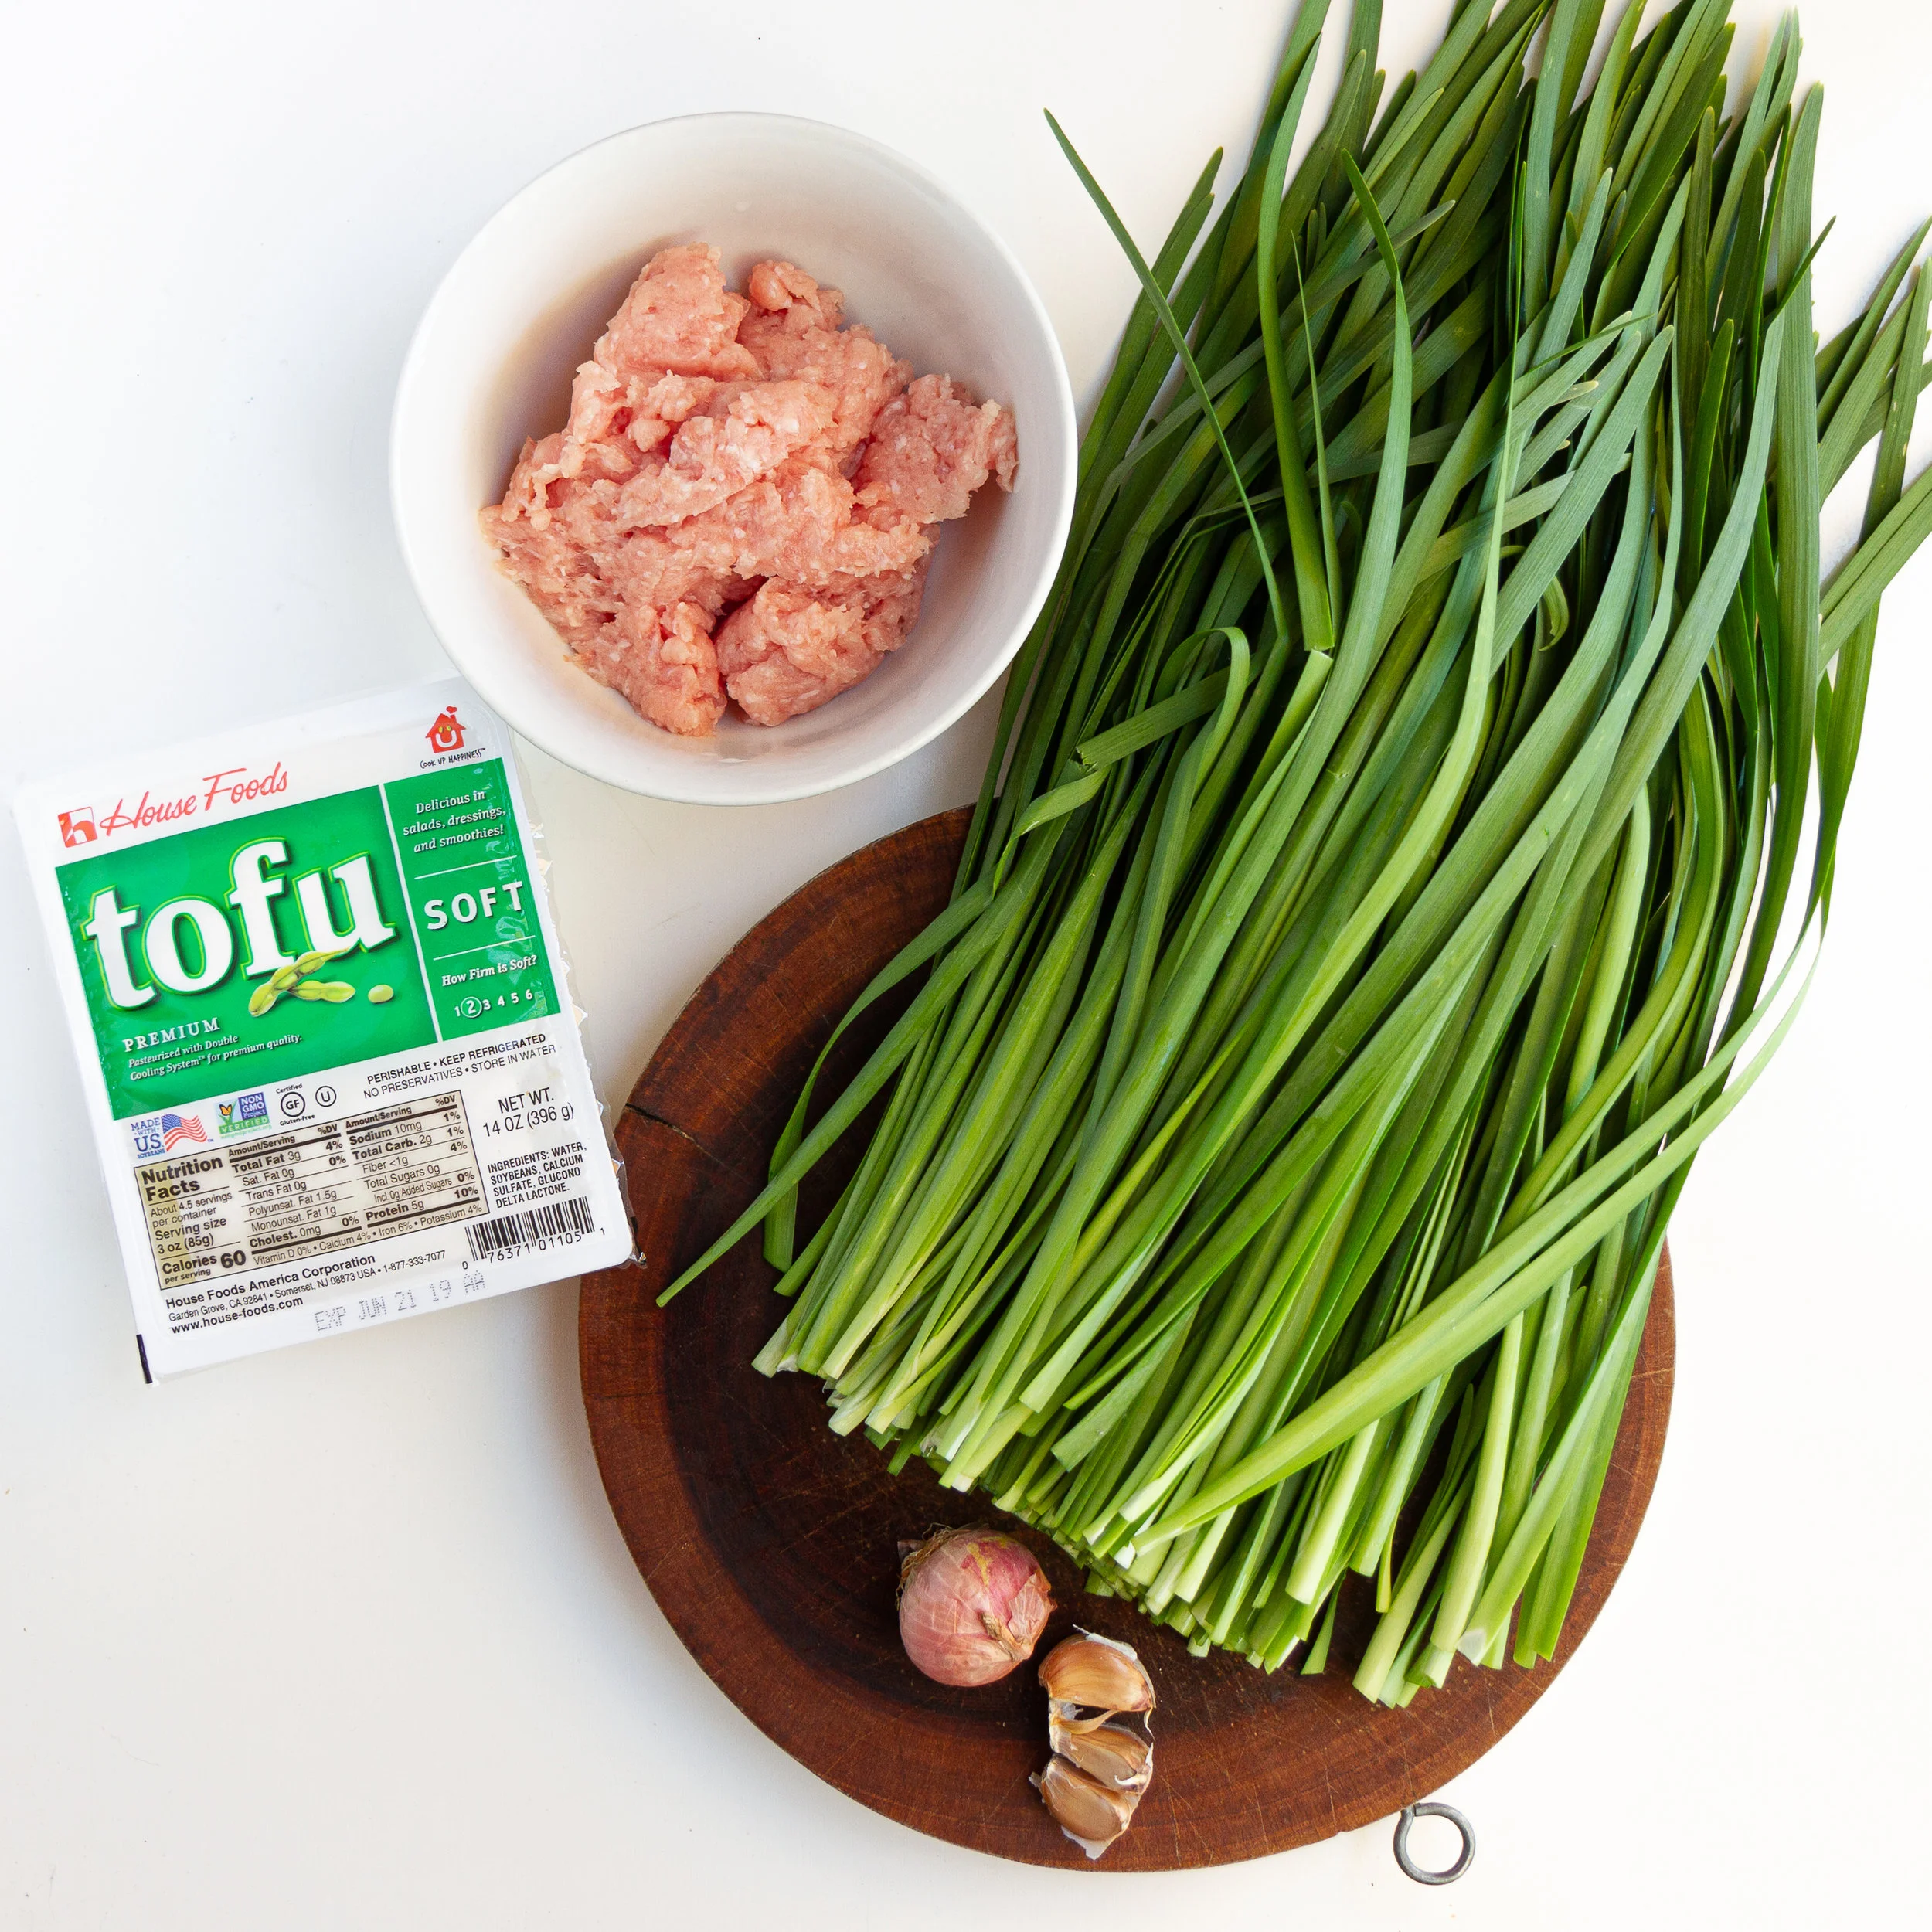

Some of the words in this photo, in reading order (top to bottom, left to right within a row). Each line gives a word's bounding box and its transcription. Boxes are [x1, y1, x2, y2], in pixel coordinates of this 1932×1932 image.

[437, 757, 446, 765] UP
[99, 791, 197, 837] House
[202, 761, 288, 811] Foods
[415, 794, 471, 815] Delicious
[472, 790, 485, 801] in
[403, 818, 447, 835] salads,
[447, 804, 506, 827] dressings,
[413, 837, 437, 853] and
[439, 823, 504, 847] smoothies!
[423, 879, 522, 931] SOFT
[80, 837, 400, 1012] tofu
[441, 973, 467, 987] How
[468, 967, 496, 981] Firm
[497, 962, 508, 974] is
[509, 954, 537, 971] Soft?
[454, 1005, 461, 1017] 1
[466, 999, 477, 1015] 2
[481, 998, 491, 1010] 3
[497, 995, 505, 1006] 4
[510, 992, 519, 1004] 5
[525, 988, 533, 1000] 6
[121, 1017, 220, 1053] PREMIUM
[128, 1047, 182, 1068] Pasteurized
[182, 1043, 205, 1055] with
[205, 1035, 239, 1050] Double
[129, 1066, 166, 1081] Cooling
[205, 1053, 222, 1065] for
[223, 1043, 267, 1061] premium
[266, 1034, 302, 1050] quality.
[367, 1061, 432, 1085] PERISHABLE
[439, 1053, 466, 1067] KEEP
[468, 1033, 546, 1060] REFRIGERATED
[363, 1087, 379, 1099] NO
[380, 1066, 464, 1094] PRESERVATIVES
[471, 1056, 506, 1073] STORE
[507, 1053, 519, 1064] IN
[519, 1044, 556, 1061] WATER
[240, 1094, 263, 1107] NON
[275, 1083, 303, 1094] Certified
[320, 1090, 331, 1103] U
[498, 1093, 525, 1114] NET
[527, 1087, 554, 1106] WT.
[242, 1101, 264, 1114] GMO
[243, 1108, 266, 1119] Project
[279, 1114, 315, 1126] Gluten-Free
[285, 1099, 300, 1111] GF
[345, 1107, 413, 1129] Amount/Serving
[434, 1094, 455, 1106] %DV
[482, 1120, 501, 1137] 14
[504, 1114, 524, 1132] OZ
[526, 1106, 557, 1130] (396
[561, 1102, 574, 1121] g)
[131, 1117, 161, 1131] MADE
[222, 1115, 270, 1134] VERIFIED
[349, 1128, 393, 1145] Sodium
[394, 1121, 423, 1138] 10mg
[443, 1111, 461, 1122] 1%
[134, 1133, 165, 1153] U.S.
[228, 1135, 296, 1157] Amount/Serving
[317, 1123, 338, 1135] %DV
[352, 1145, 383, 1160] Total
[385, 1138, 417, 1152] Carb.
[419, 1134, 434, 1148] 2g
[447, 1126, 464, 1137] 1%
[141, 1157, 223, 1185] Nutrition
[231, 1158, 263, 1173] Total
[264, 1153, 285, 1166] Fat
[287, 1148, 303, 1165] 3g
[325, 1139, 343, 1151] 4%
[242, 1175, 262, 1187] Sat.
[263, 1171, 281, 1182] Fat
[281, 1168, 295, 1182] 0g
[328, 1155, 347, 1166] 0%
[362, 1161, 386, 1174] Fiber
[387, 1154, 410, 1172] <1g
[450, 1141, 468, 1151] 4%
[487, 1150, 550, 1174] INGREDIENTS:
[551, 1141, 587, 1158] WATER,
[490, 1165, 541, 1185] SOYBEANS,
[543, 1154, 583, 1172] CALCIUM
[145, 1180, 201, 1202] Facts
[245, 1189, 274, 1201] Trans
[275, 1183, 293, 1195] Fat
[294, 1181, 307, 1192] 0g
[363, 1175, 389, 1189] Total
[389, 1168, 428, 1187] Sugars
[427, 1165, 440, 1175] 0g
[401, 1183, 425, 1197] Added
[425, 1178, 454, 1194] Sugars
[457, 1171, 475, 1182] 0%
[493, 1179, 536, 1197] SULFATE,
[537, 1166, 581, 1185] GLUCONO
[151, 1203, 178, 1218] About
[179, 1199, 193, 1210] 4.5
[195, 1192, 233, 1208] servings
[248, 1199, 294, 1221] Polyunsat.
[298, 1194, 314, 1206] Fat
[316, 1189, 337, 1201] 1.5g
[365, 1203, 410, 1221] Protein
[410, 1198, 427, 1214] 5g
[454, 1186, 479, 1199] 10%
[495, 1193, 525, 1209] DELTA
[526, 1182, 570, 1201] LACTONE.
[152, 1218, 168, 1230] per
[171, 1207, 216, 1225] container
[155, 1223, 200, 1241] Serving
[202, 1217, 226, 1230] size
[249, 1230, 298, 1248] Cholest.
[299, 1226, 321, 1237] 0mg
[342, 1216, 359, 1227] 0%
[251, 1213, 304, 1232] Monounsat.
[306, 1208, 322, 1219] Fat
[324, 1206, 338, 1219] 1g
[157, 1243, 165, 1254] 3
[167, 1242, 182, 1253] oz
[184, 1233, 214, 1251] (85g)
[253, 1251, 286, 1265] Vitamin
[287, 1248, 295, 1258] D
[296, 1245, 312, 1257] 0%
[318, 1236, 355, 1251] Calcium
[356, 1232, 372, 1241] 4%
[378, 1226, 396, 1236] Iron
[397, 1221, 413, 1232] 6%
[420, 1209, 466, 1226] Potassium
[468, 1204, 482, 1214] 4%
[461, 1260, 468, 1270] 0
[487, 1243, 530, 1264] 76371
[538, 1230, 582, 1251] 01105
[600, 1227, 605, 1236] 1
[162, 1255, 217, 1274] Calories
[220, 1250, 247, 1269] 60
[164, 1275, 179, 1285] per
[180, 1268, 211, 1281] serving
[165, 1294, 205, 1309] House
[206, 1284, 246, 1301] Foods
[250, 1273, 300, 1291] America
[301, 1255, 376, 1279] Corporation
[168, 1309, 199, 1322] Garden
[200, 1304, 228, 1315] Grove,
[229, 1298, 243, 1308] CA
[242, 1292, 267, 1305] 92841
[274, 1283, 316, 1298] Somerset,
[316, 1277, 329, 1288] NJ
[329, 1272, 356, 1285] 08873
[356, 1267, 377, 1279] USA
[383, 1250, 446, 1273] 1-877-333-7077
[171, 1298, 304, 1334] www.house-foods.com
[314, 1306, 346, 1332] EXP
[358, 1296, 387, 1321] JUN
[394, 1289, 417, 1311] 21
[429, 1279, 451, 1302] 19
[463, 1270, 486, 1294] AA
